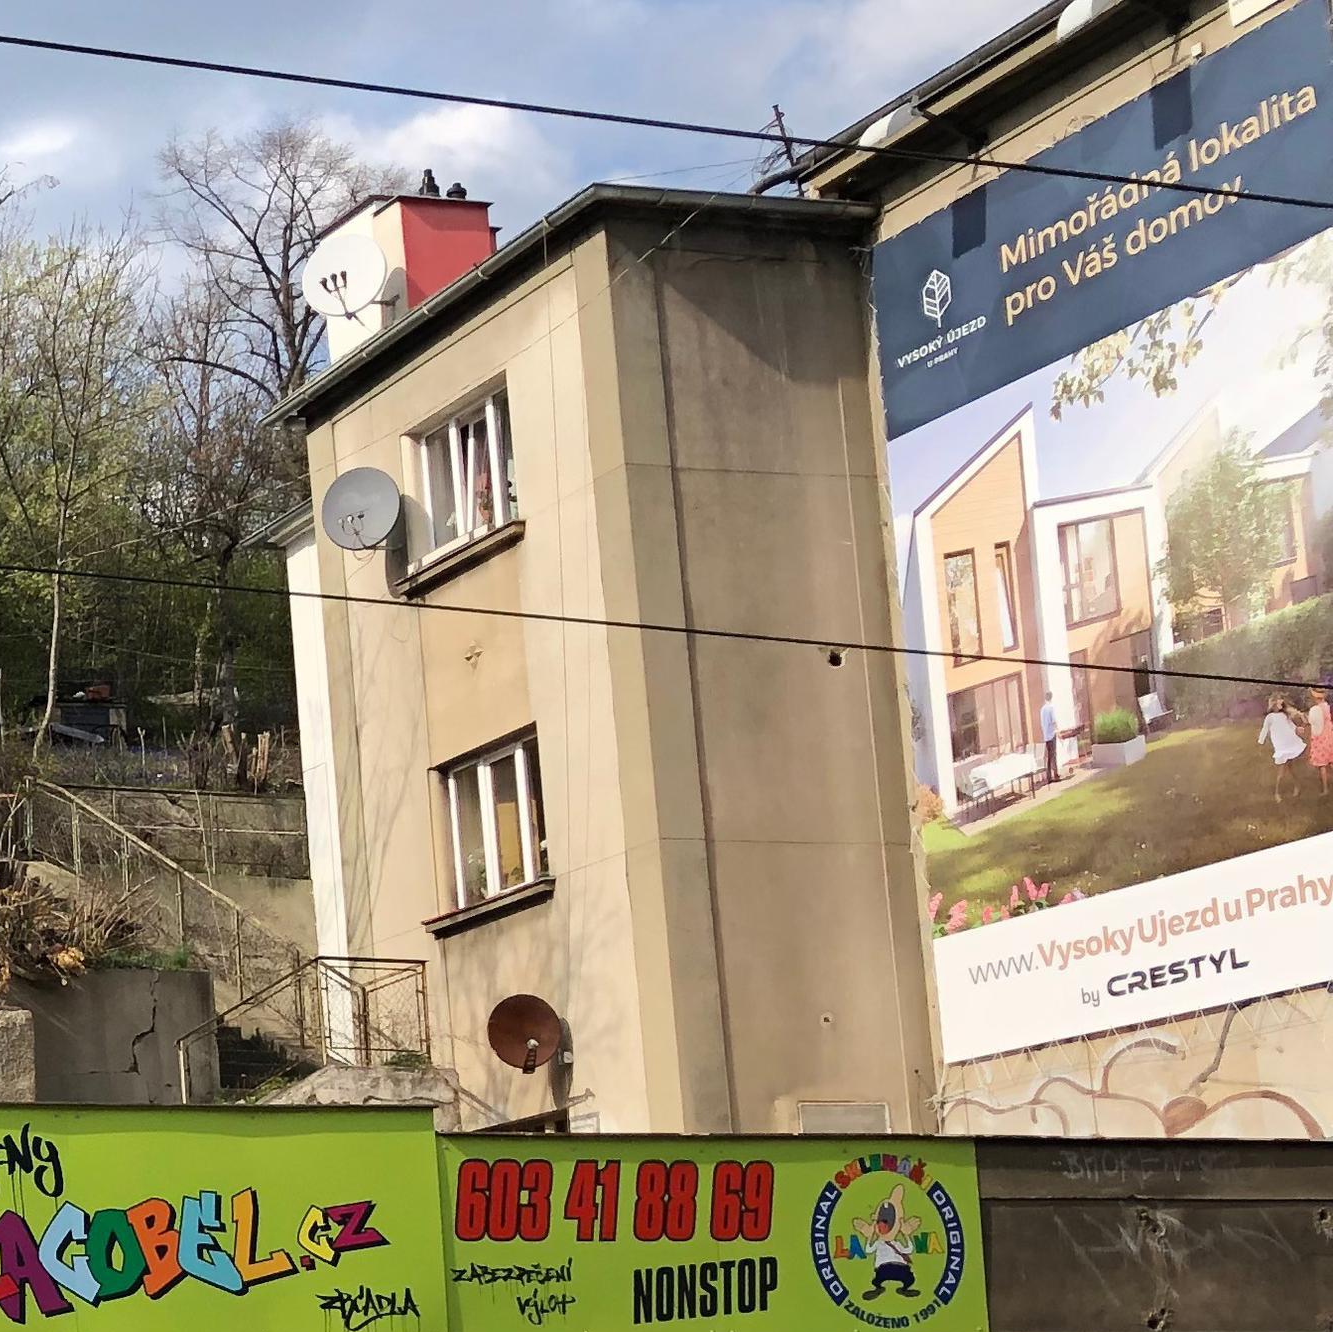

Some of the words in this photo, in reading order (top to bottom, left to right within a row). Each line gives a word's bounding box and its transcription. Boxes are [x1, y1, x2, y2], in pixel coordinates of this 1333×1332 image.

[1000, 151, 1181, 273] Mimořádná
[1189, 85, 1317, 172] lokalita
[1005, 274, 1056, 325] pro
[1063, 233, 1118, 287] Váš
[897, 335, 943, 368] VYSOKÝ
[946, 316, 986, 343] ÚJEZD
[1081, 987, 1100, 1006] by
[1107, 948, 1250, 997] CRESTYL
[455, 1159, 552, 1242] 603
[564, 1159, 618, 1242] 41
[634, 1159, 699, 1242] 88
[710, 1160, 775, 1242] 69
[932, 1189, 961, 1295] ORIGINAL
[813, 1190, 844, 1296] ORIGINAL
[633, 1257, 778, 1325] NONSTOP
[844, 1300, 909, 1328] ZALOŽENO
[913, 1299, 945, 1323] 1991
